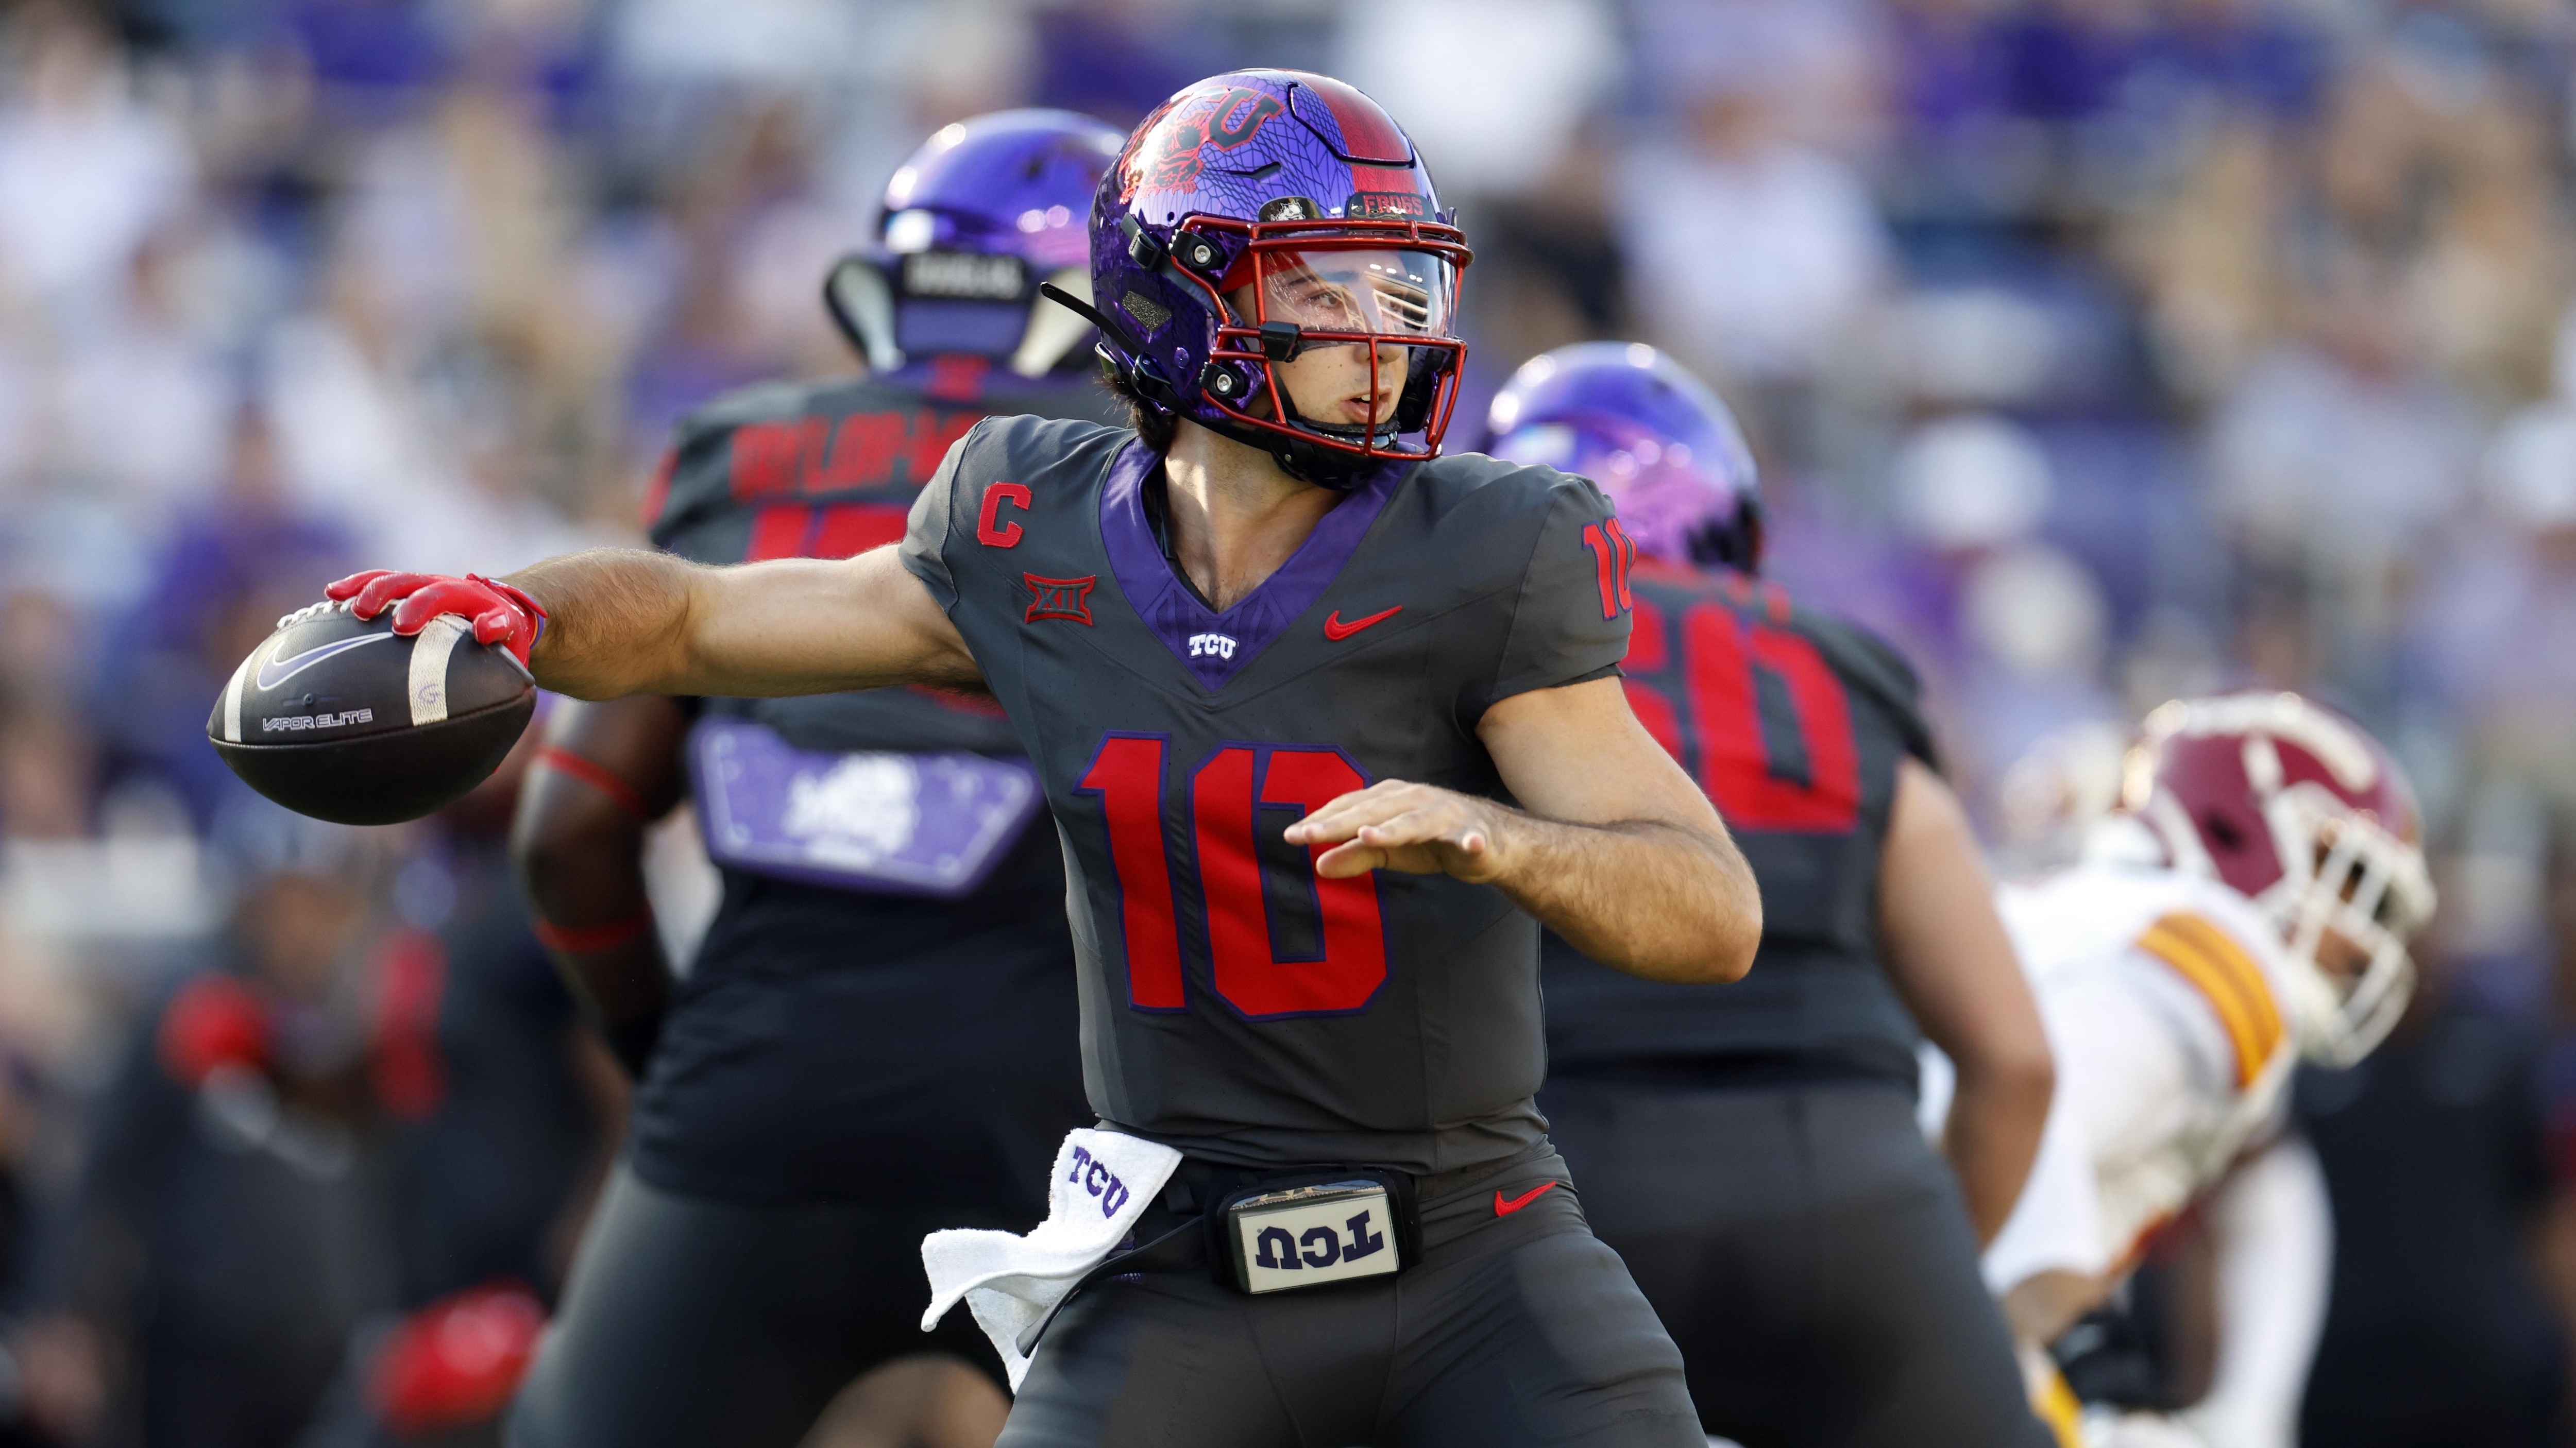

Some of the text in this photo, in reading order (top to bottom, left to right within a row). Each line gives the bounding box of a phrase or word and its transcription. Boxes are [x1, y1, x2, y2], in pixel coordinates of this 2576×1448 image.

[1363, 194, 1423, 216] FROGS
[977, 482, 1032, 548] C
[1029, 580, 1090, 618] XII
[1188, 633, 1238, 660] TCU
[262, 708, 374, 731] VAPOR ELITE
[1071, 729, 1392, 1023] 10
[1069, 1146, 1129, 1219] TCU
[1255, 1209, 1384, 1270] TCU
